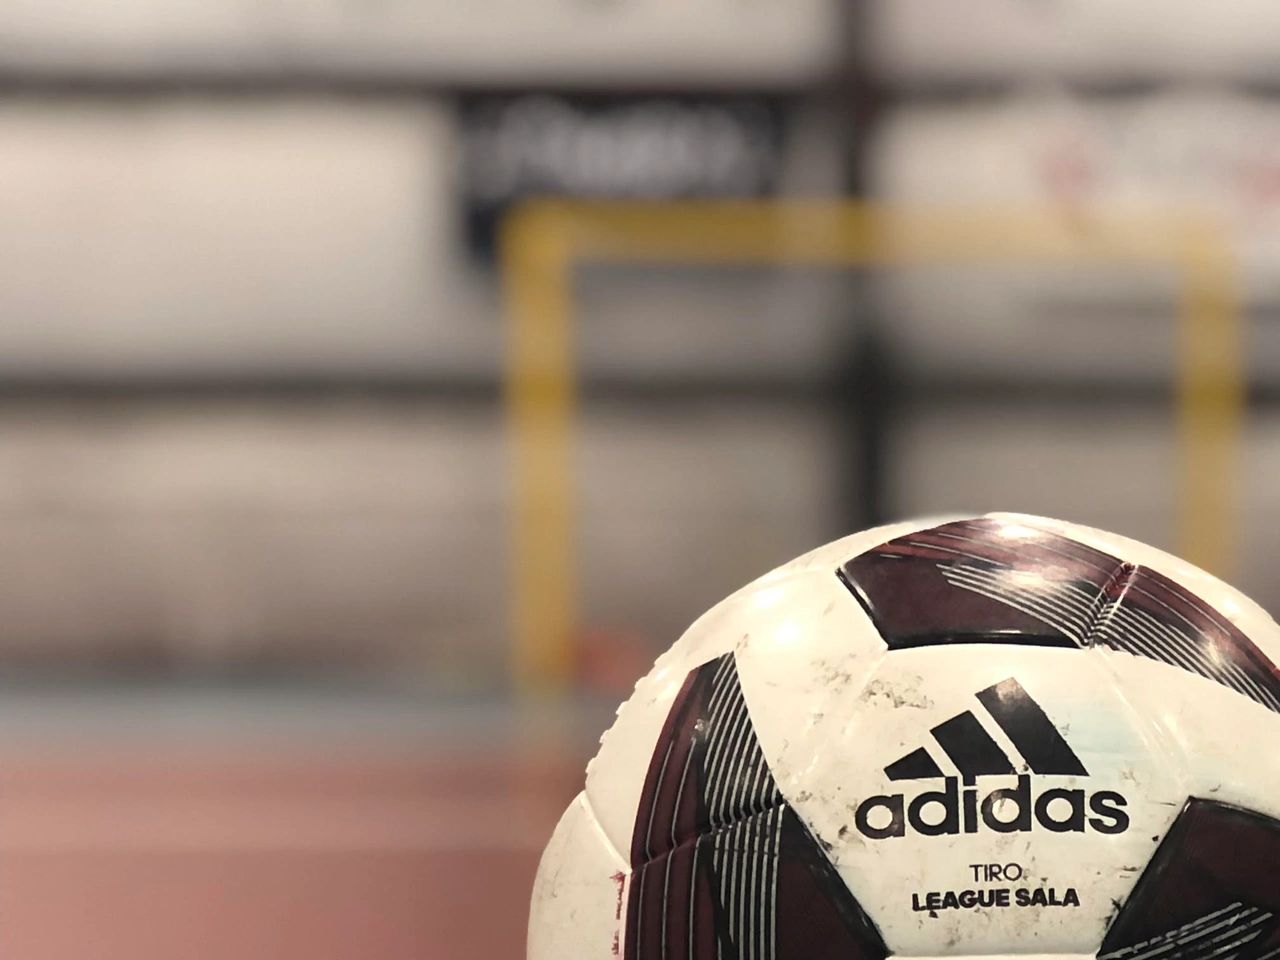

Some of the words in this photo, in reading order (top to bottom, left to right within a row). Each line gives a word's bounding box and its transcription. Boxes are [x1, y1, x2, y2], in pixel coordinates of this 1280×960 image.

[855, 773, 1130, 840] adidas
[969, 863, 1023, 882] TIRO
[912, 888, 1010, 911] LEAGUE
[1015, 887, 1080, 907] SALA
